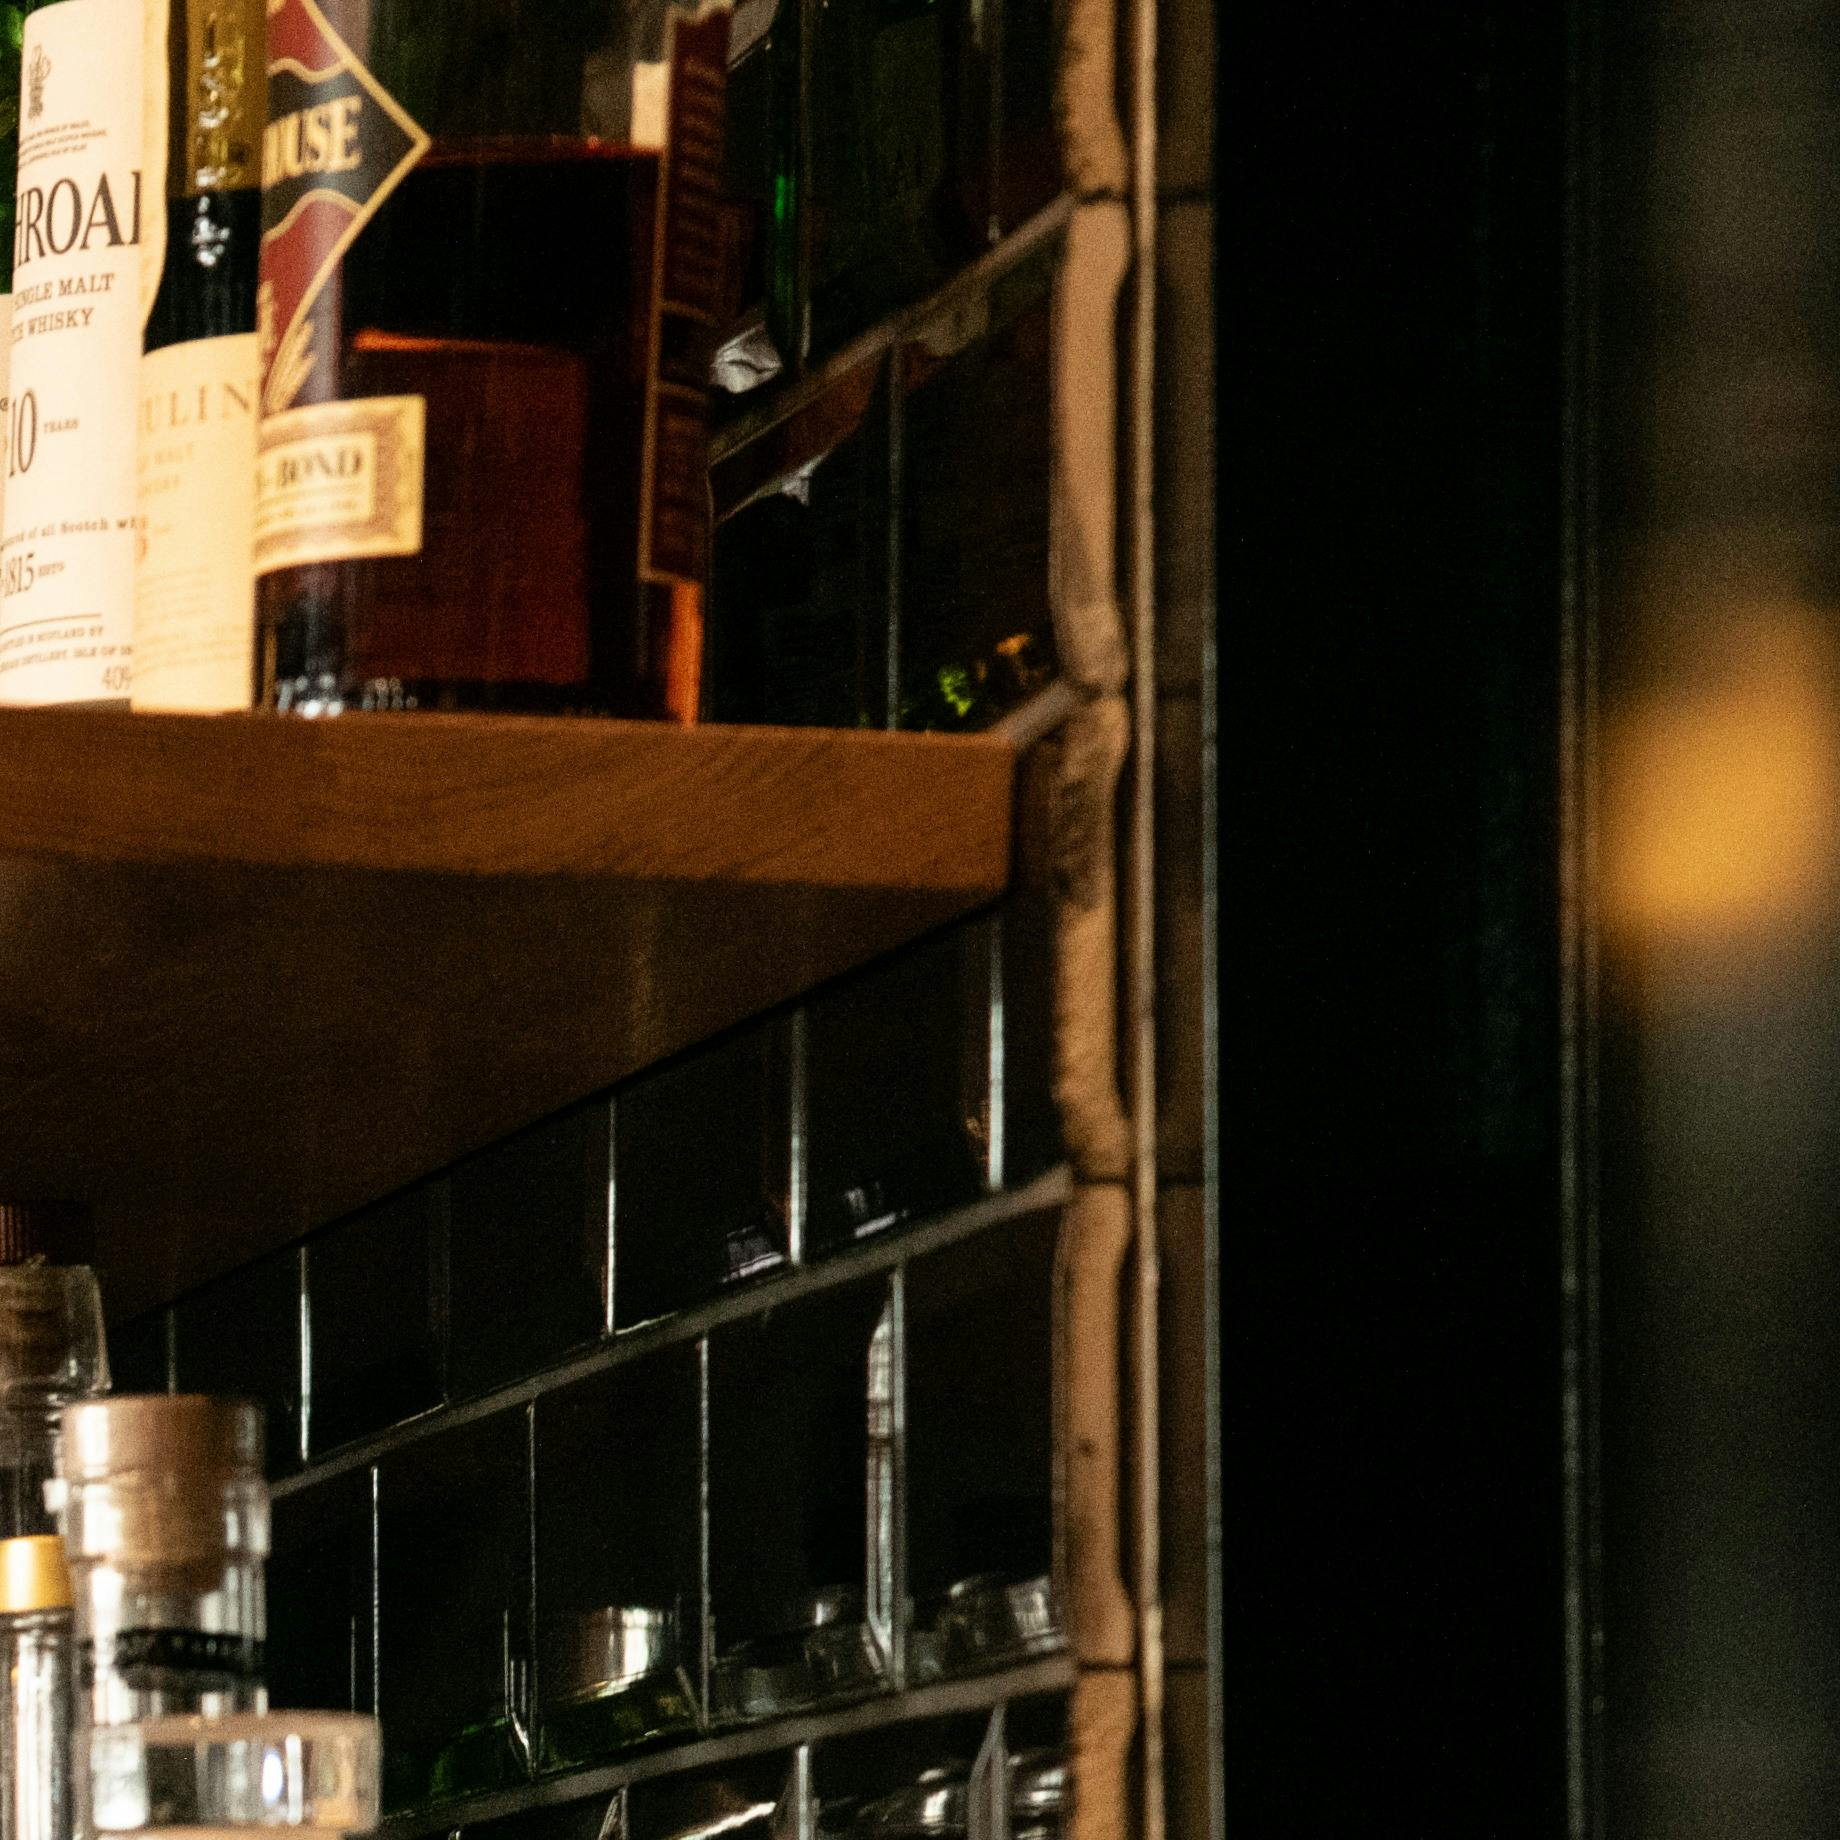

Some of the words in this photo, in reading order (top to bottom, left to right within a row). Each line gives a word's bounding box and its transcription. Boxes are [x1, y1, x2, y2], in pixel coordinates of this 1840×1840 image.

[59, 273, 114, 297] MALT
[28, 307, 94, 336] WHISKY
[9, 387, 37, 478] 10
[61, 517, 109, 534] Scotch
[3, 551, 35, 597] 815
